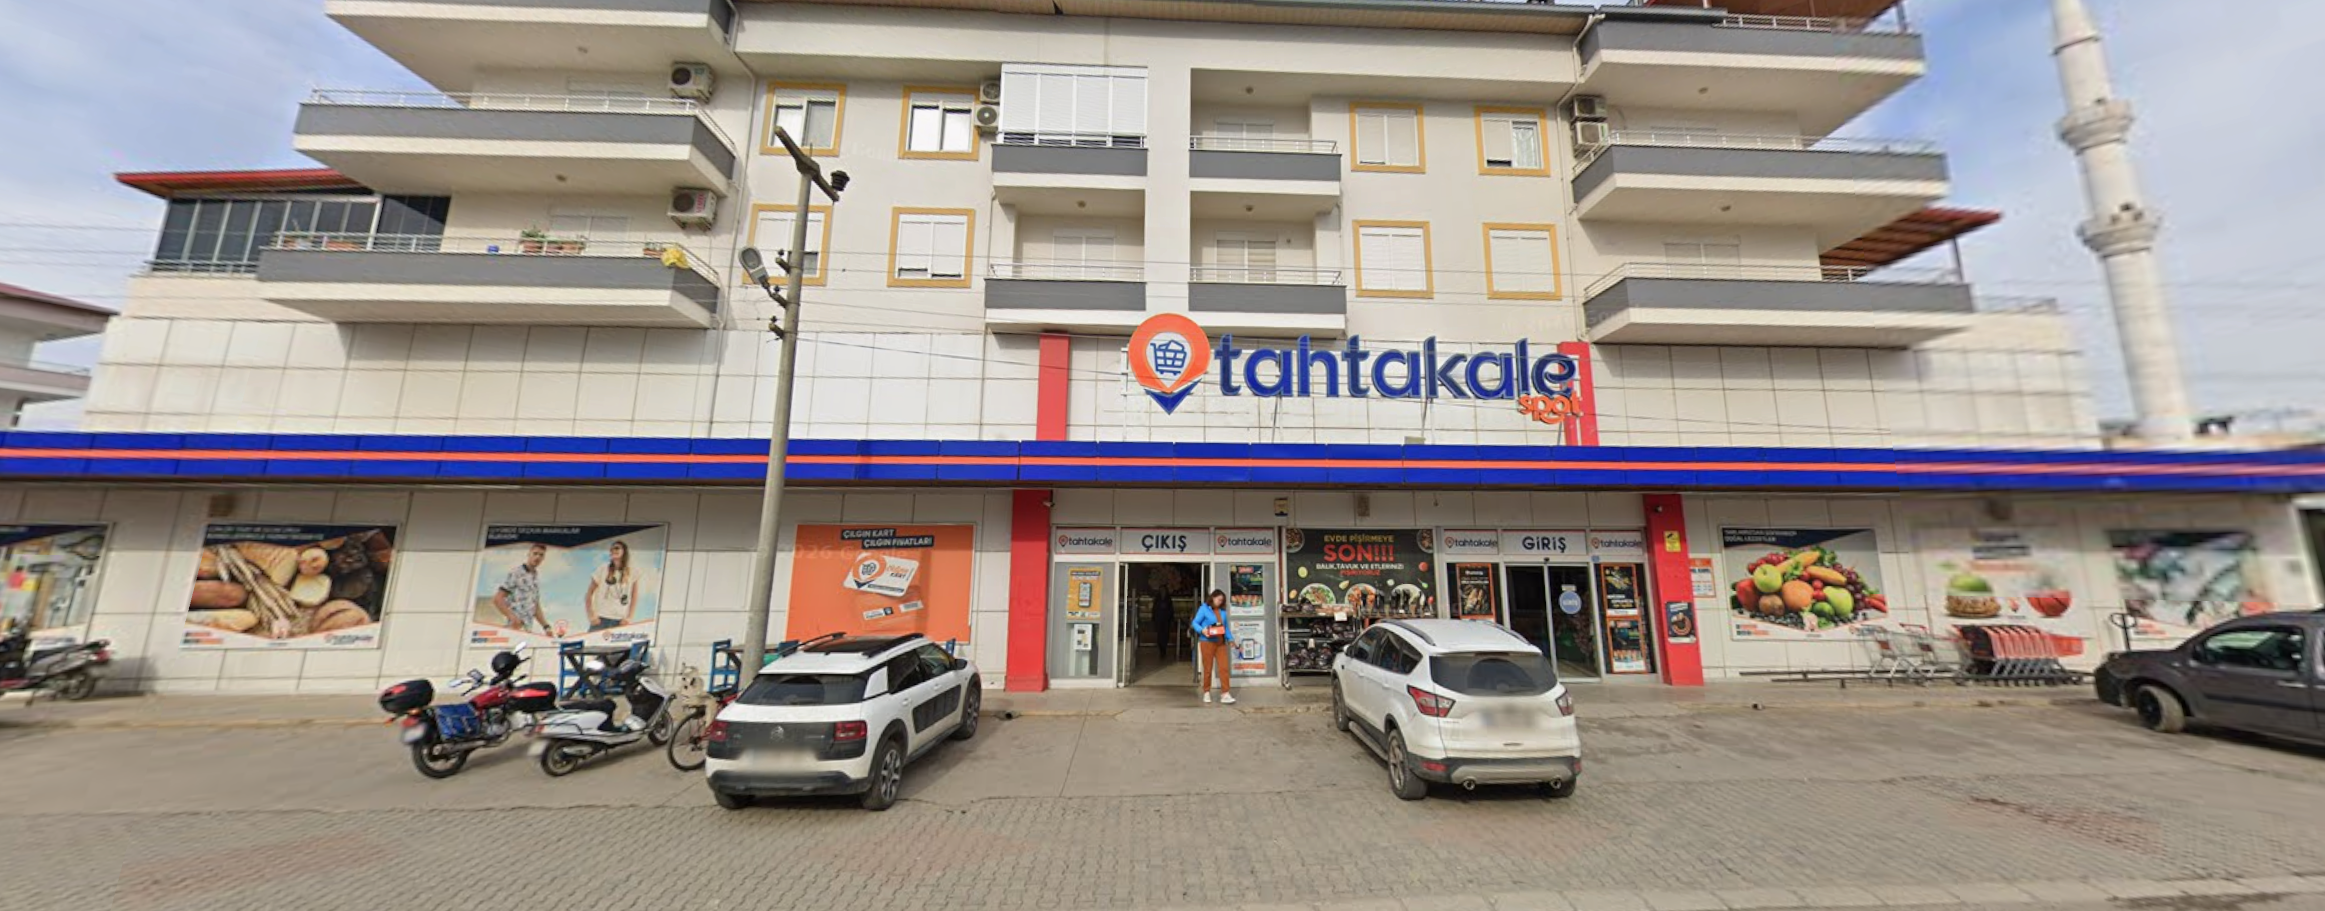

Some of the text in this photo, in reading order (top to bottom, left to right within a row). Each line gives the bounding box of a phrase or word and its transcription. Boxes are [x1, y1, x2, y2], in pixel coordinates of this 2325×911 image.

[1214, 333, 1577, 400] tahtakale
[1518, 393, 1583, 424] spot
[842, 529, 895, 538] ÇILGIN KART
[863, 539, 892, 548] ÇILGIN
[1068, 536, 1113, 546] tahtakale
[1141, 534, 1187, 552] ÇIKIŞ
[1228, 537, 1272, 547] tahtakale
[1350, 534, 1394, 544] PİŞİRMEYE
[1455, 539, 1498, 548] tahtakale
[1522, 535, 1567, 553] GİRİŞ
[1600, 539, 1642, 548] tahtakale
[1324, 544, 1394, 562] SON!!!
